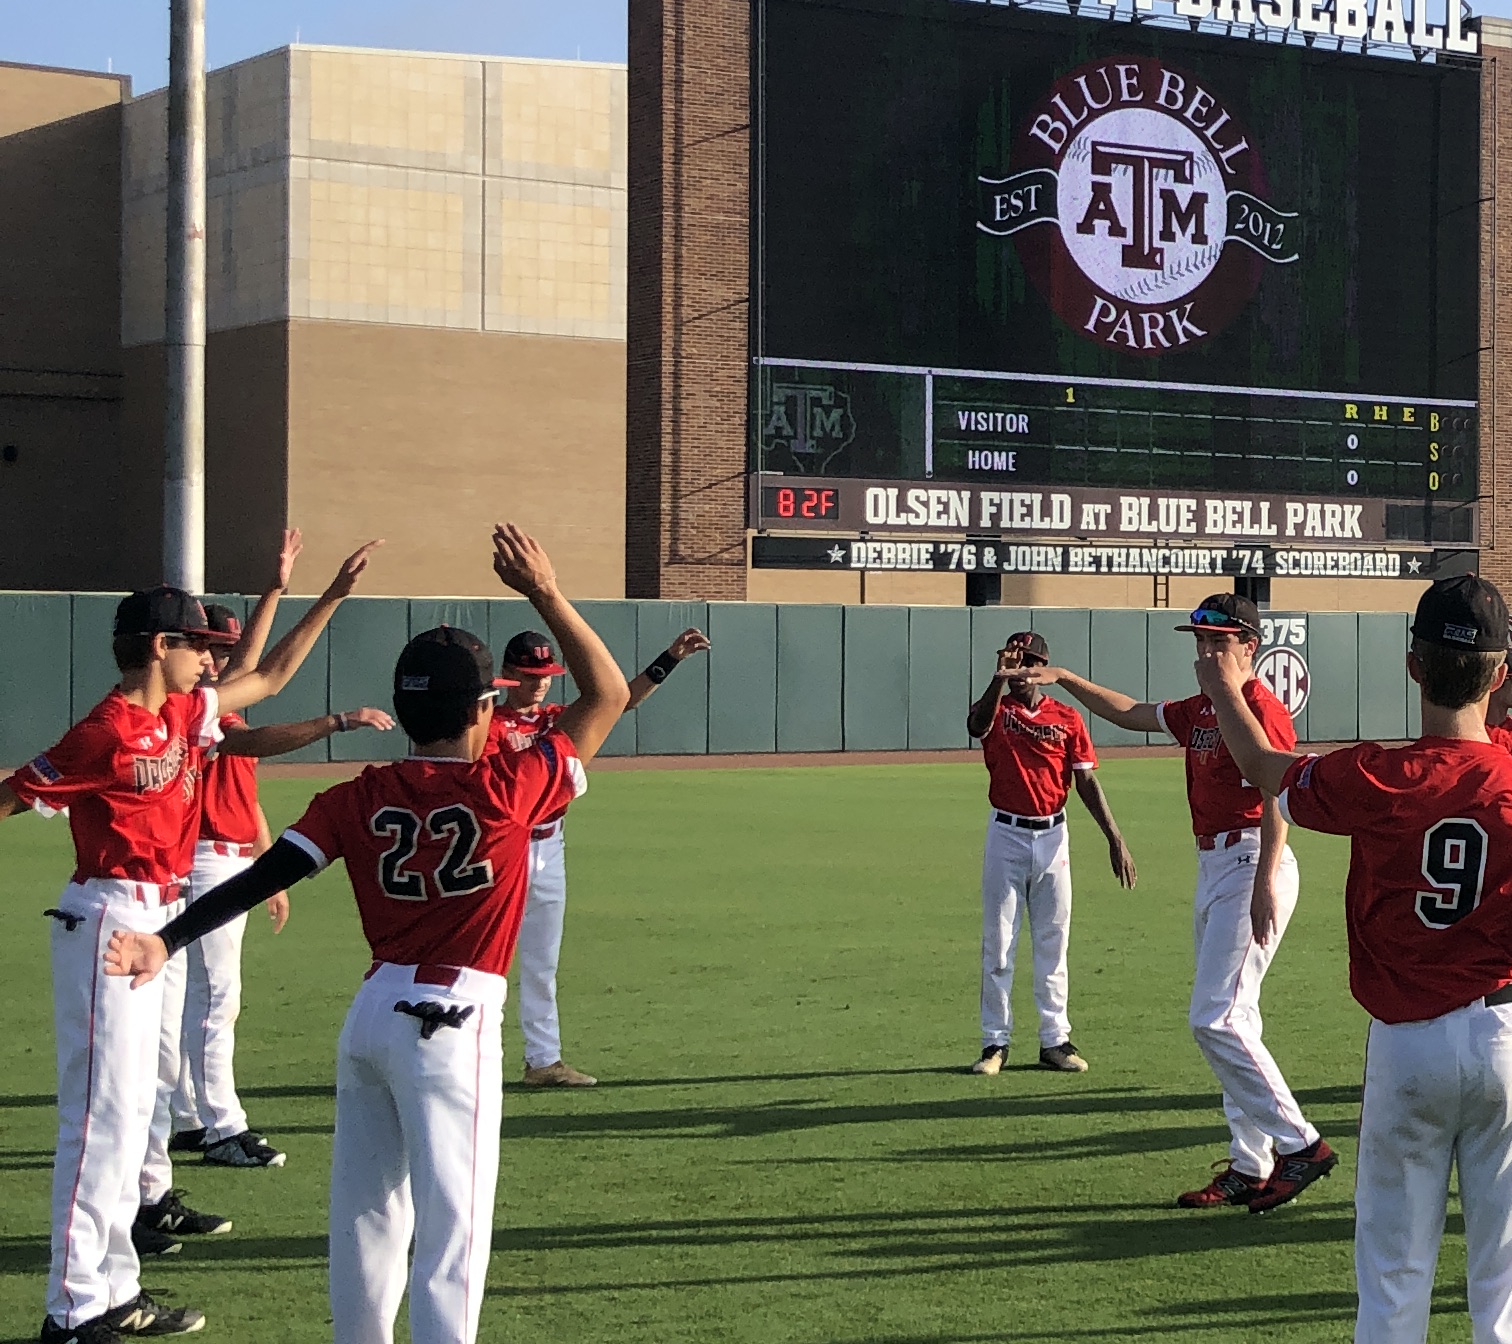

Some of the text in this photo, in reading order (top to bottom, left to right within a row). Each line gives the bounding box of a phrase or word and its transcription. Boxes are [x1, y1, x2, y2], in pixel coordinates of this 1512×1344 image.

[1028, 63, 1249, 174] BLUE BELL
[994, 184, 1043, 222] EST
[1234, 204, 1285, 250] 2012
[1084, 295, 1208, 349] PARK
[1065, 387, 1076, 403] 1
[1345, 403, 1415, 422] R H E
[957, 411, 1029, 433] VISITOR
[1430, 412, 1439, 432] B
[968, 449, 1017, 471] HOME
[1429, 442, 1439, 461] S
[776, 488, 835, 518] 82F
[865, 487, 1363, 538] OLSEN FIELD AT BLUE BELL PARK
[850, 541, 1400, 577] DEBBIE '76 & JOHN BETHANCOURT '74 SCOREBOARD
[1260, 618, 1306, 646] 375
[1257, 652, 1305, 713] SEC
[370, 803, 494, 901] 22
[1414, 817, 1488, 930] 9
